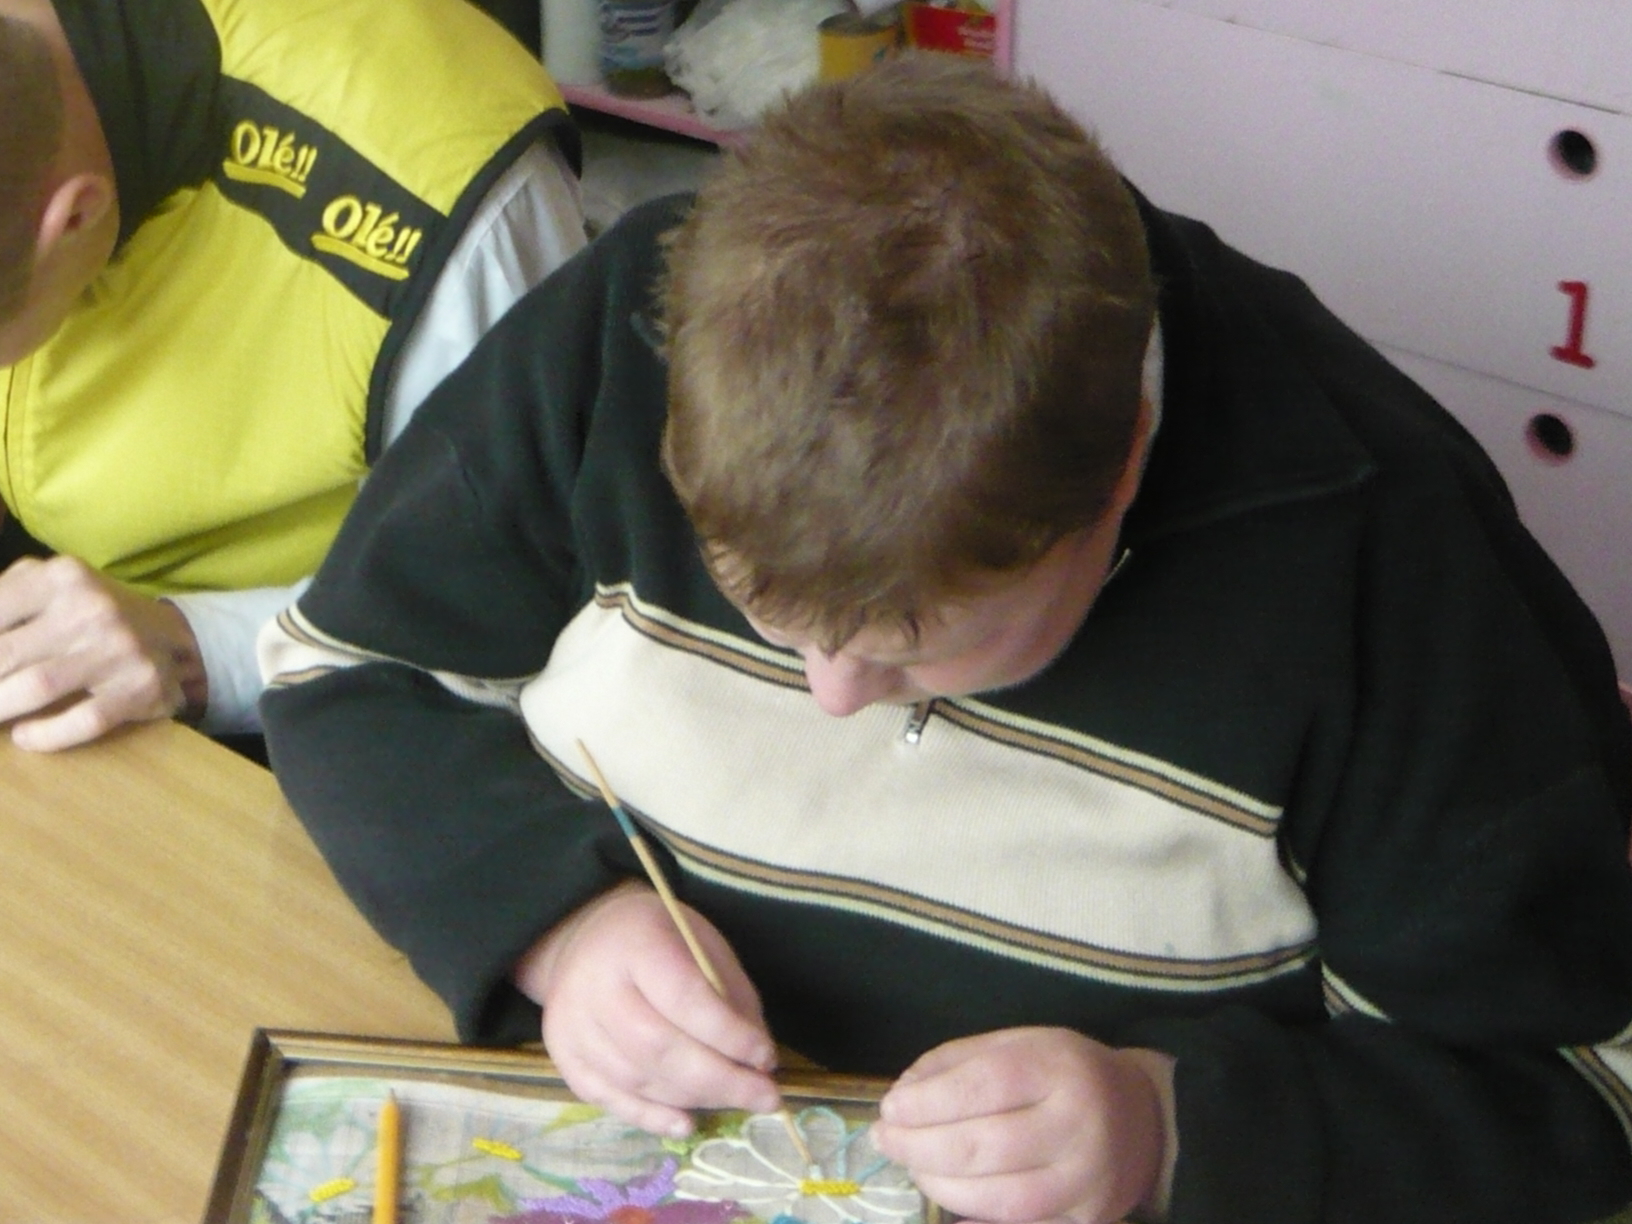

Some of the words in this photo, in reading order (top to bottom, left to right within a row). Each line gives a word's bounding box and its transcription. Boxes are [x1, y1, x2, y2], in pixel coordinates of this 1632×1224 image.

[231, 121, 318, 183] Olé!!
[322, 194, 422, 264] Olé!!
[1549, 280, 1595, 369] 1
